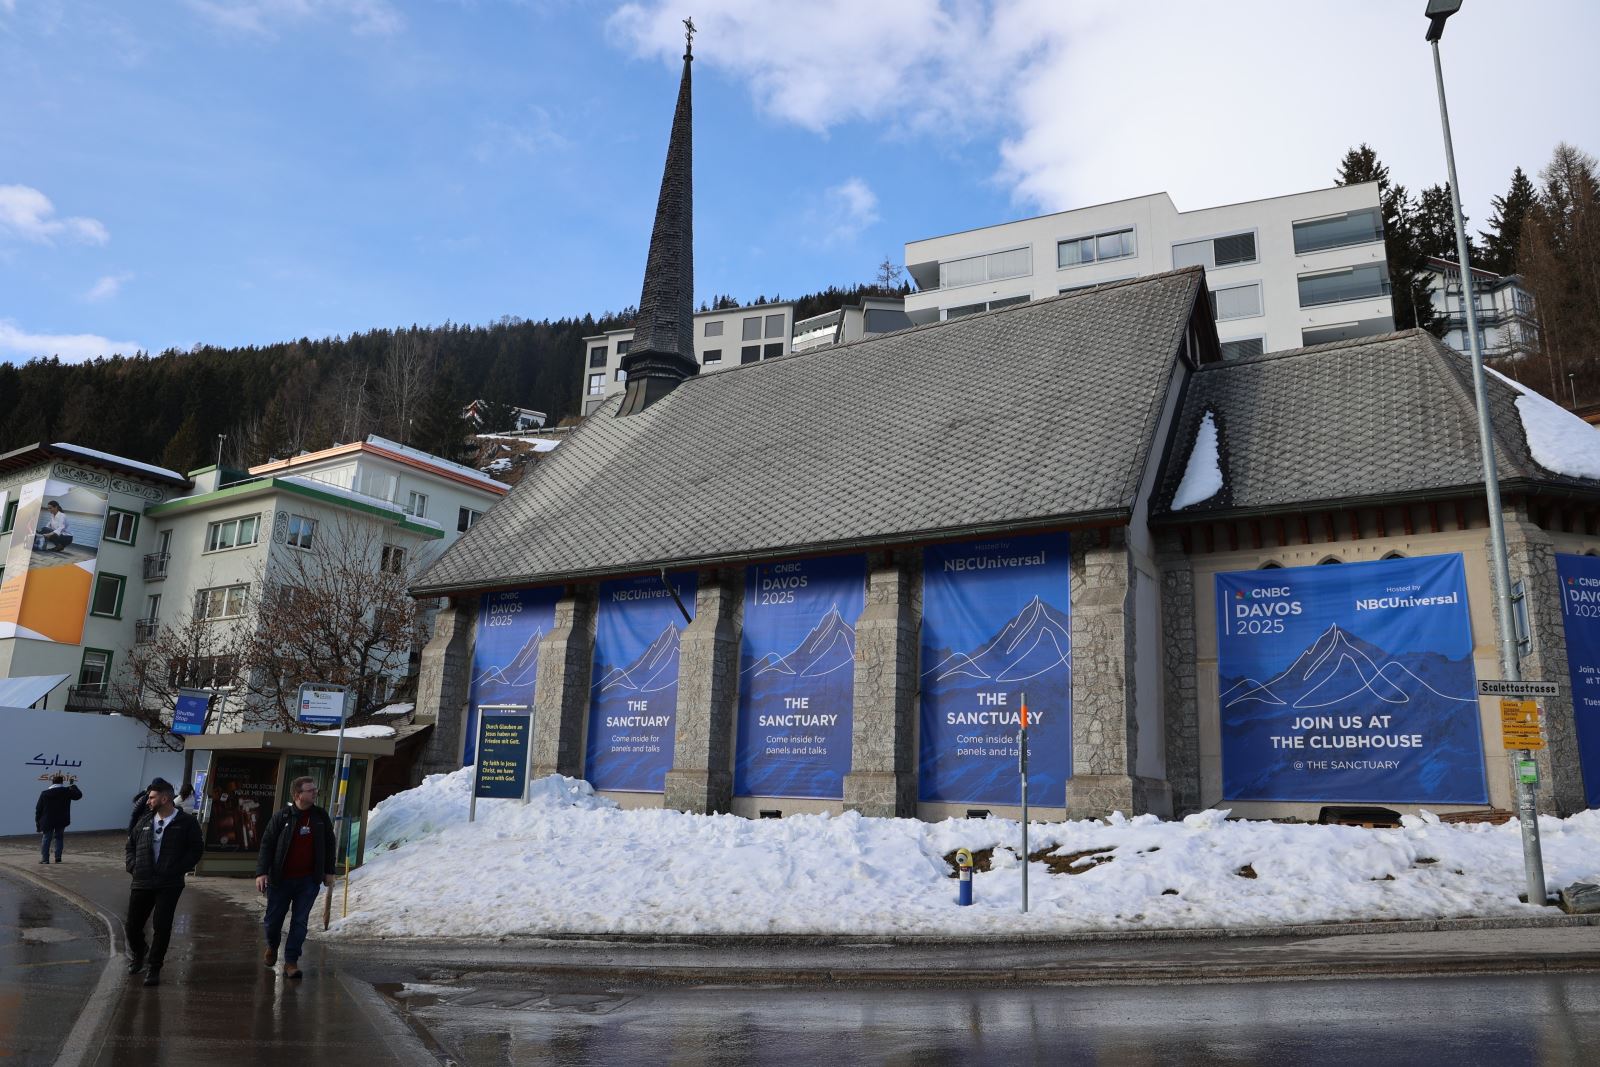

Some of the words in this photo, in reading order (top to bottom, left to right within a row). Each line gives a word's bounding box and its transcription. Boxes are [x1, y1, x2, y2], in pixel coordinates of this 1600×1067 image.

[944, 550, 1045, 572] NBCUniversal
[775, 563, 801, 573] CNBC
[763, 576, 808, 590] DAVOS
[1579, 578, 1600, 586] CNB
[762, 591, 794, 605] 2025
[1252, 587, 1291, 598] CNBC
[1356, 592, 1458, 611] NBCUniversal
[491, 603, 523, 614] DAVOS
[1236, 601, 1302, 618] DAVOS
[490, 615, 512, 626] 2025
[1237, 619, 1284, 635] 2025
[1578, 665, 1594, 674] Join
[1482, 682, 1556, 693] Scalettastrasse
[784, 698, 809, 709] THE
[977, 692, 1007, 705] THE
[628, 701, 647, 711] THE
[606, 716, 670, 727] SANCTUARY
[759, 714, 837, 726] SANCTUARY
[1291, 717, 1333, 730] JOIN
[1339, 716, 1362, 729] US
[1368, 716, 1391, 728] AT
[957, 735, 983, 743] Come
[986, 734, 1012, 743] inside
[1270, 736, 1304, 748] THE
[1310, 734, 1423, 748] CLUBHOUSE
[766, 746, 790, 755] panels
[809, 747, 826, 755] talks
[957, 747, 986, 757] panels
[989, 747, 1006, 756] and
[1009, 747, 1031, 756] tas
[1294, 761, 1304, 771] @
[1307, 761, 1328, 769] THE
[1331, 760, 1400, 769] SANCTUARY
